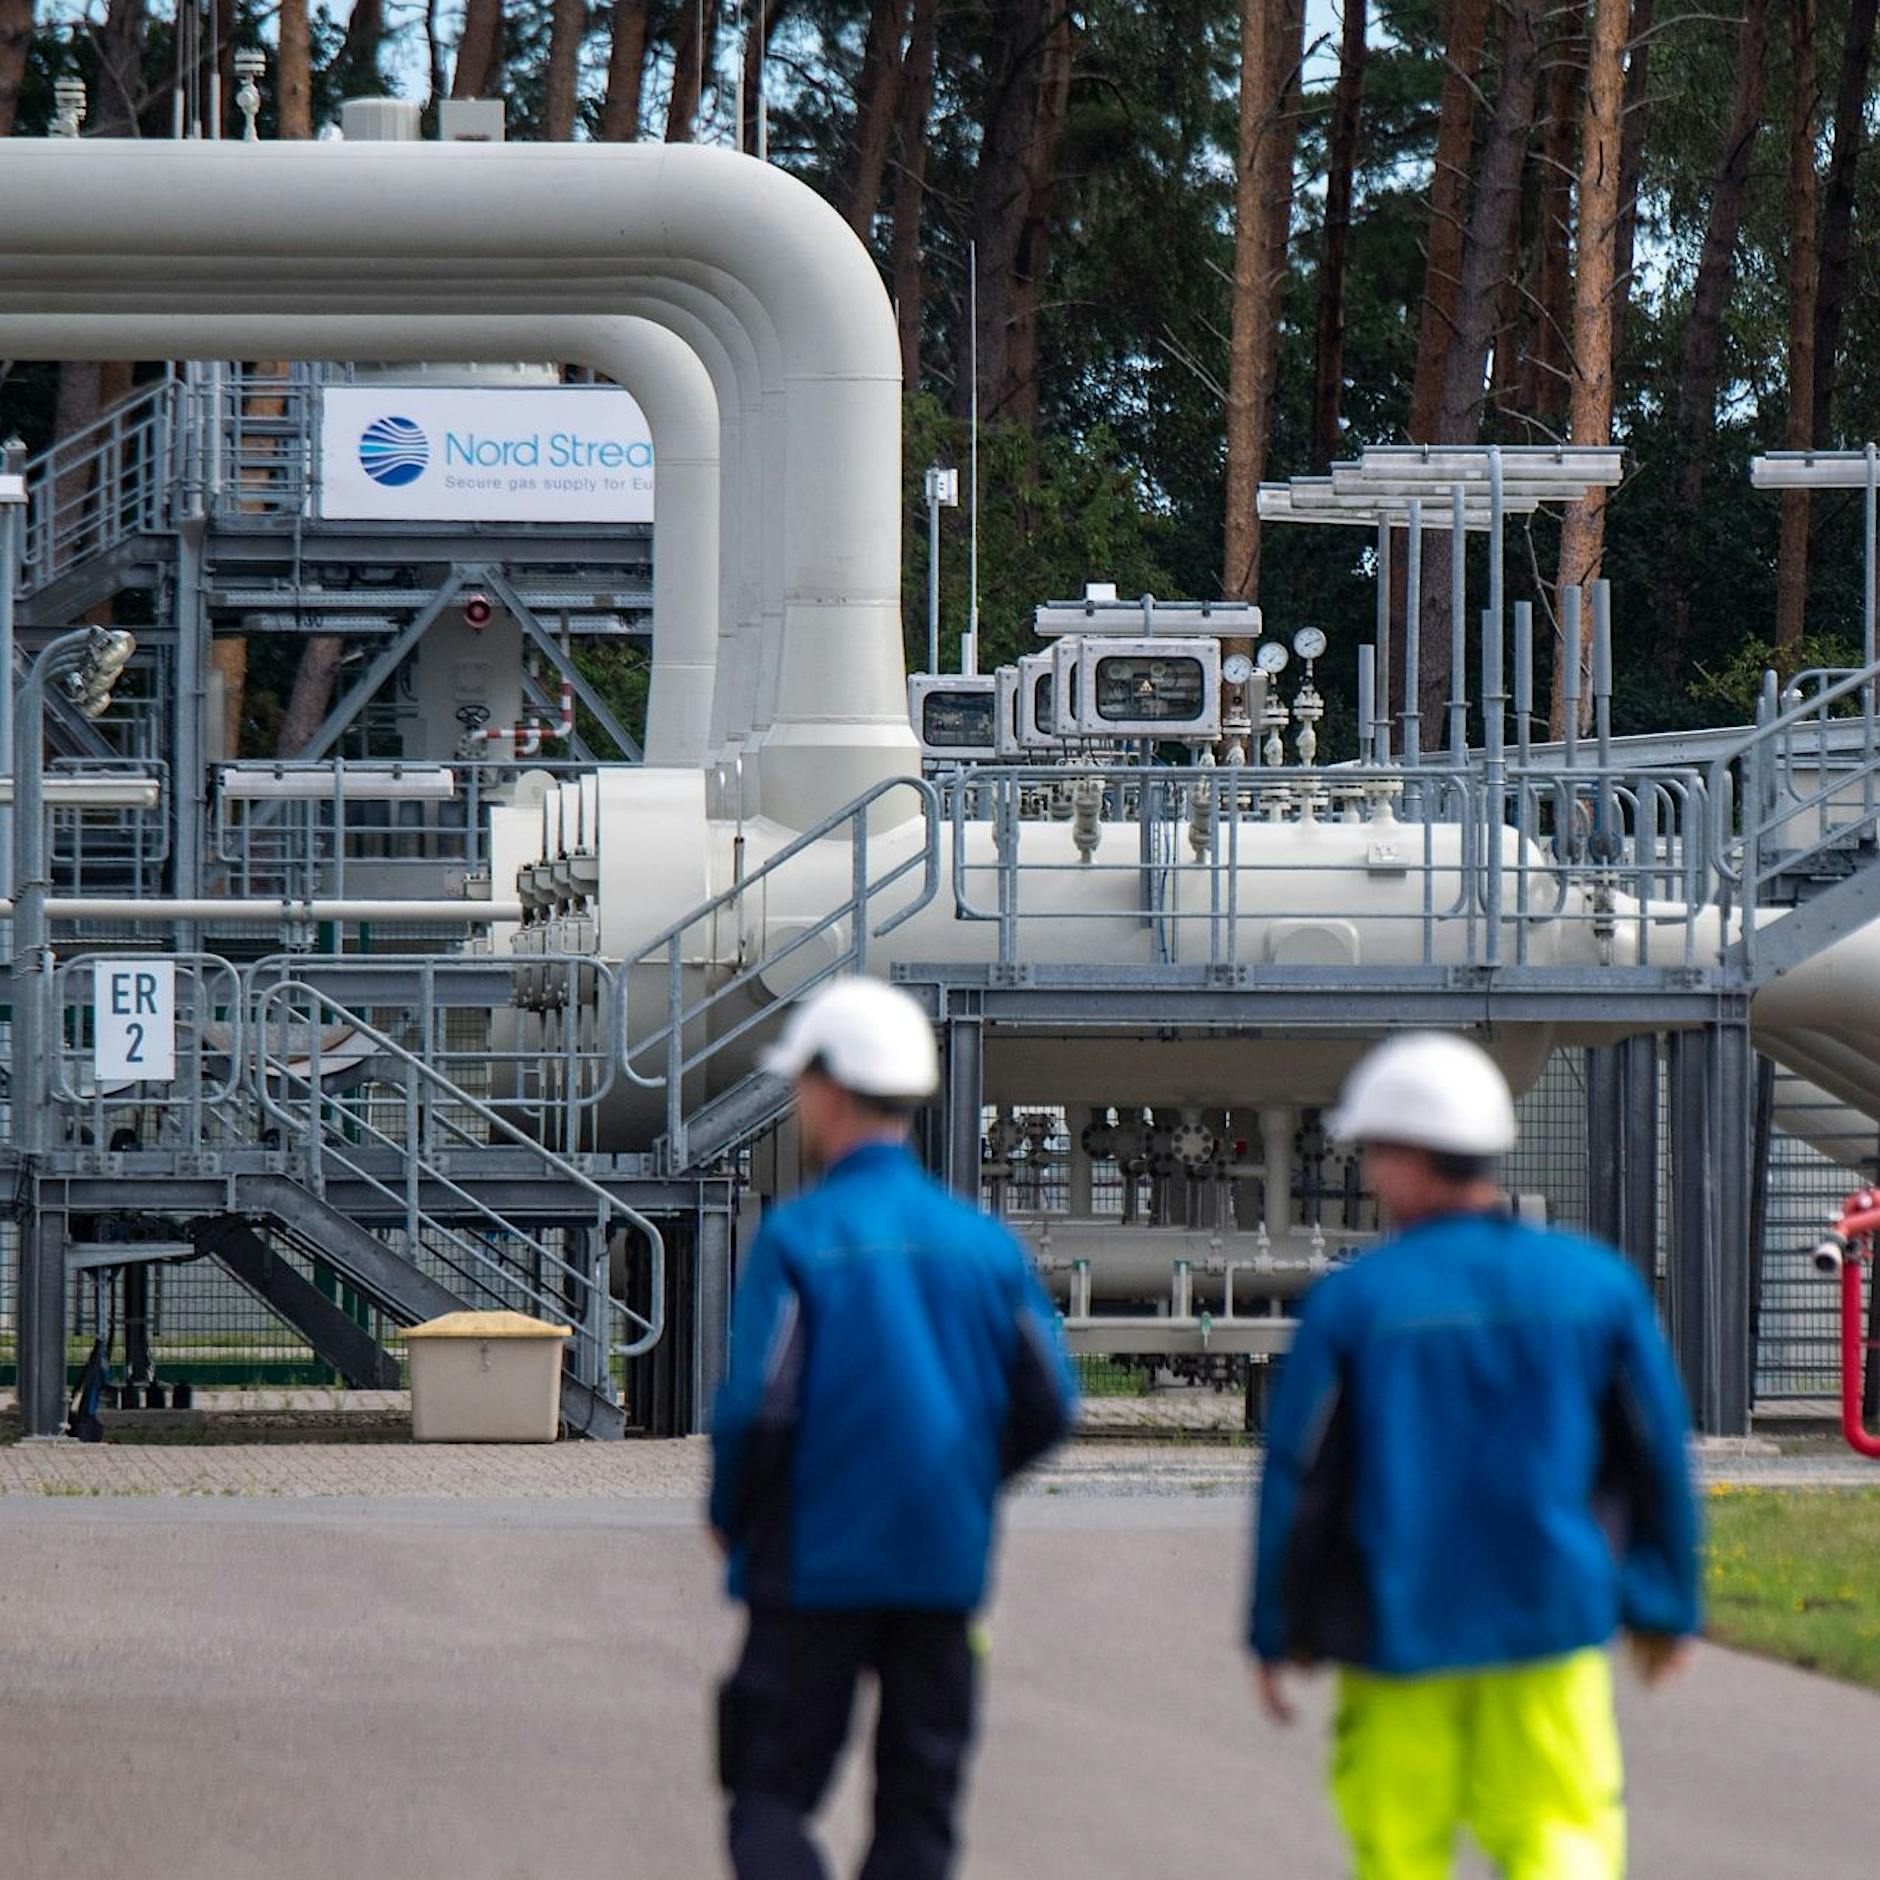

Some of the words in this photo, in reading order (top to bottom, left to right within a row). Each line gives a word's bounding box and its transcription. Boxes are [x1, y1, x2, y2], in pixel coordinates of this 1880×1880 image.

[446, 432, 538, 467] Nord
[549, 433, 652, 468] Strea
[445, 475, 501, 490] Secure
[509, 479, 537, 493] gas
[544, 477, 597, 494] supply
[604, 477, 625, 490] for
[111, 972, 158, 1016] ER
[125, 1021, 145, 1063] 2
